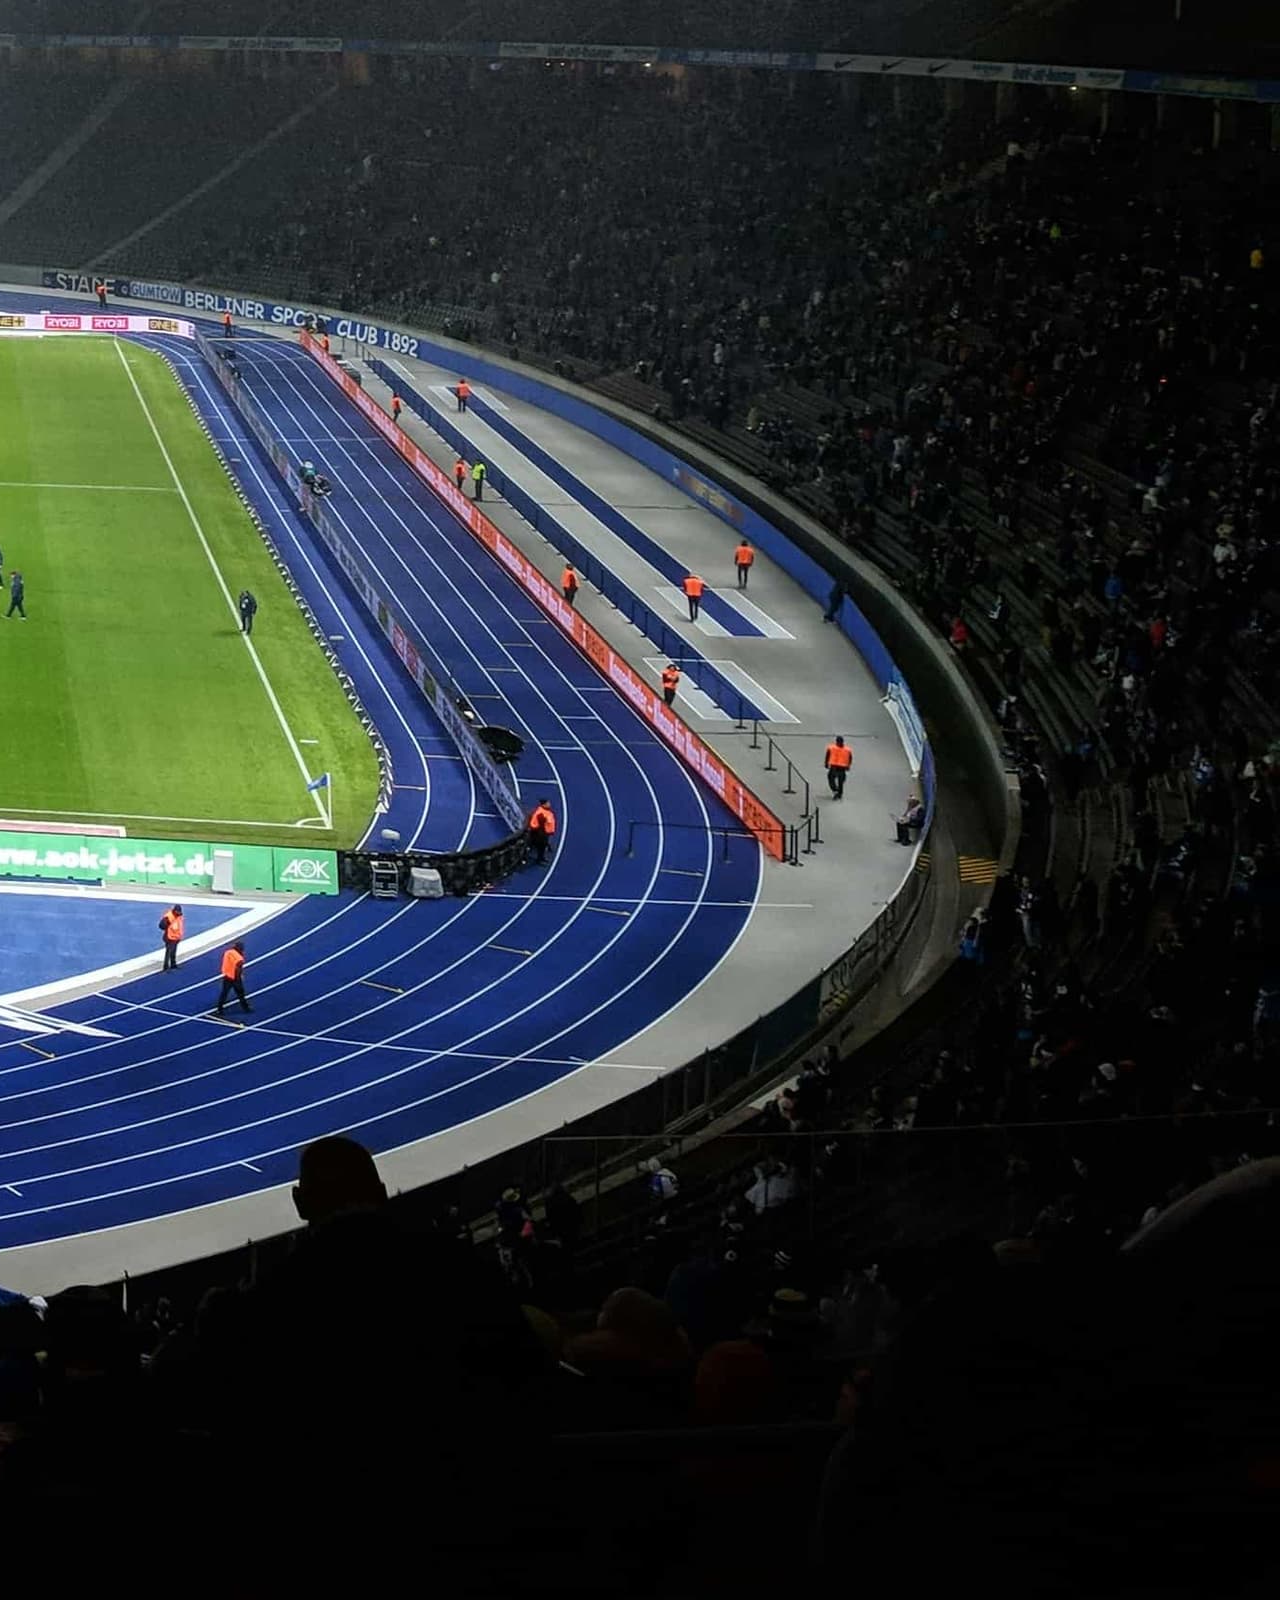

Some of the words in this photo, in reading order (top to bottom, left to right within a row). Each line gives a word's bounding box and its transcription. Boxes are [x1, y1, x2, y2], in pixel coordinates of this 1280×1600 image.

[130, 281, 182, 303] GUMTOW
[45, 316, 81, 329] RYOBI
[92, 317, 128, 330] RYOBI
[185, 290, 265, 319] BERLINER
[336, 320, 378, 345] CLUB
[383, 331, 419, 357] 1892
[280, 858, 331, 880] AOK
